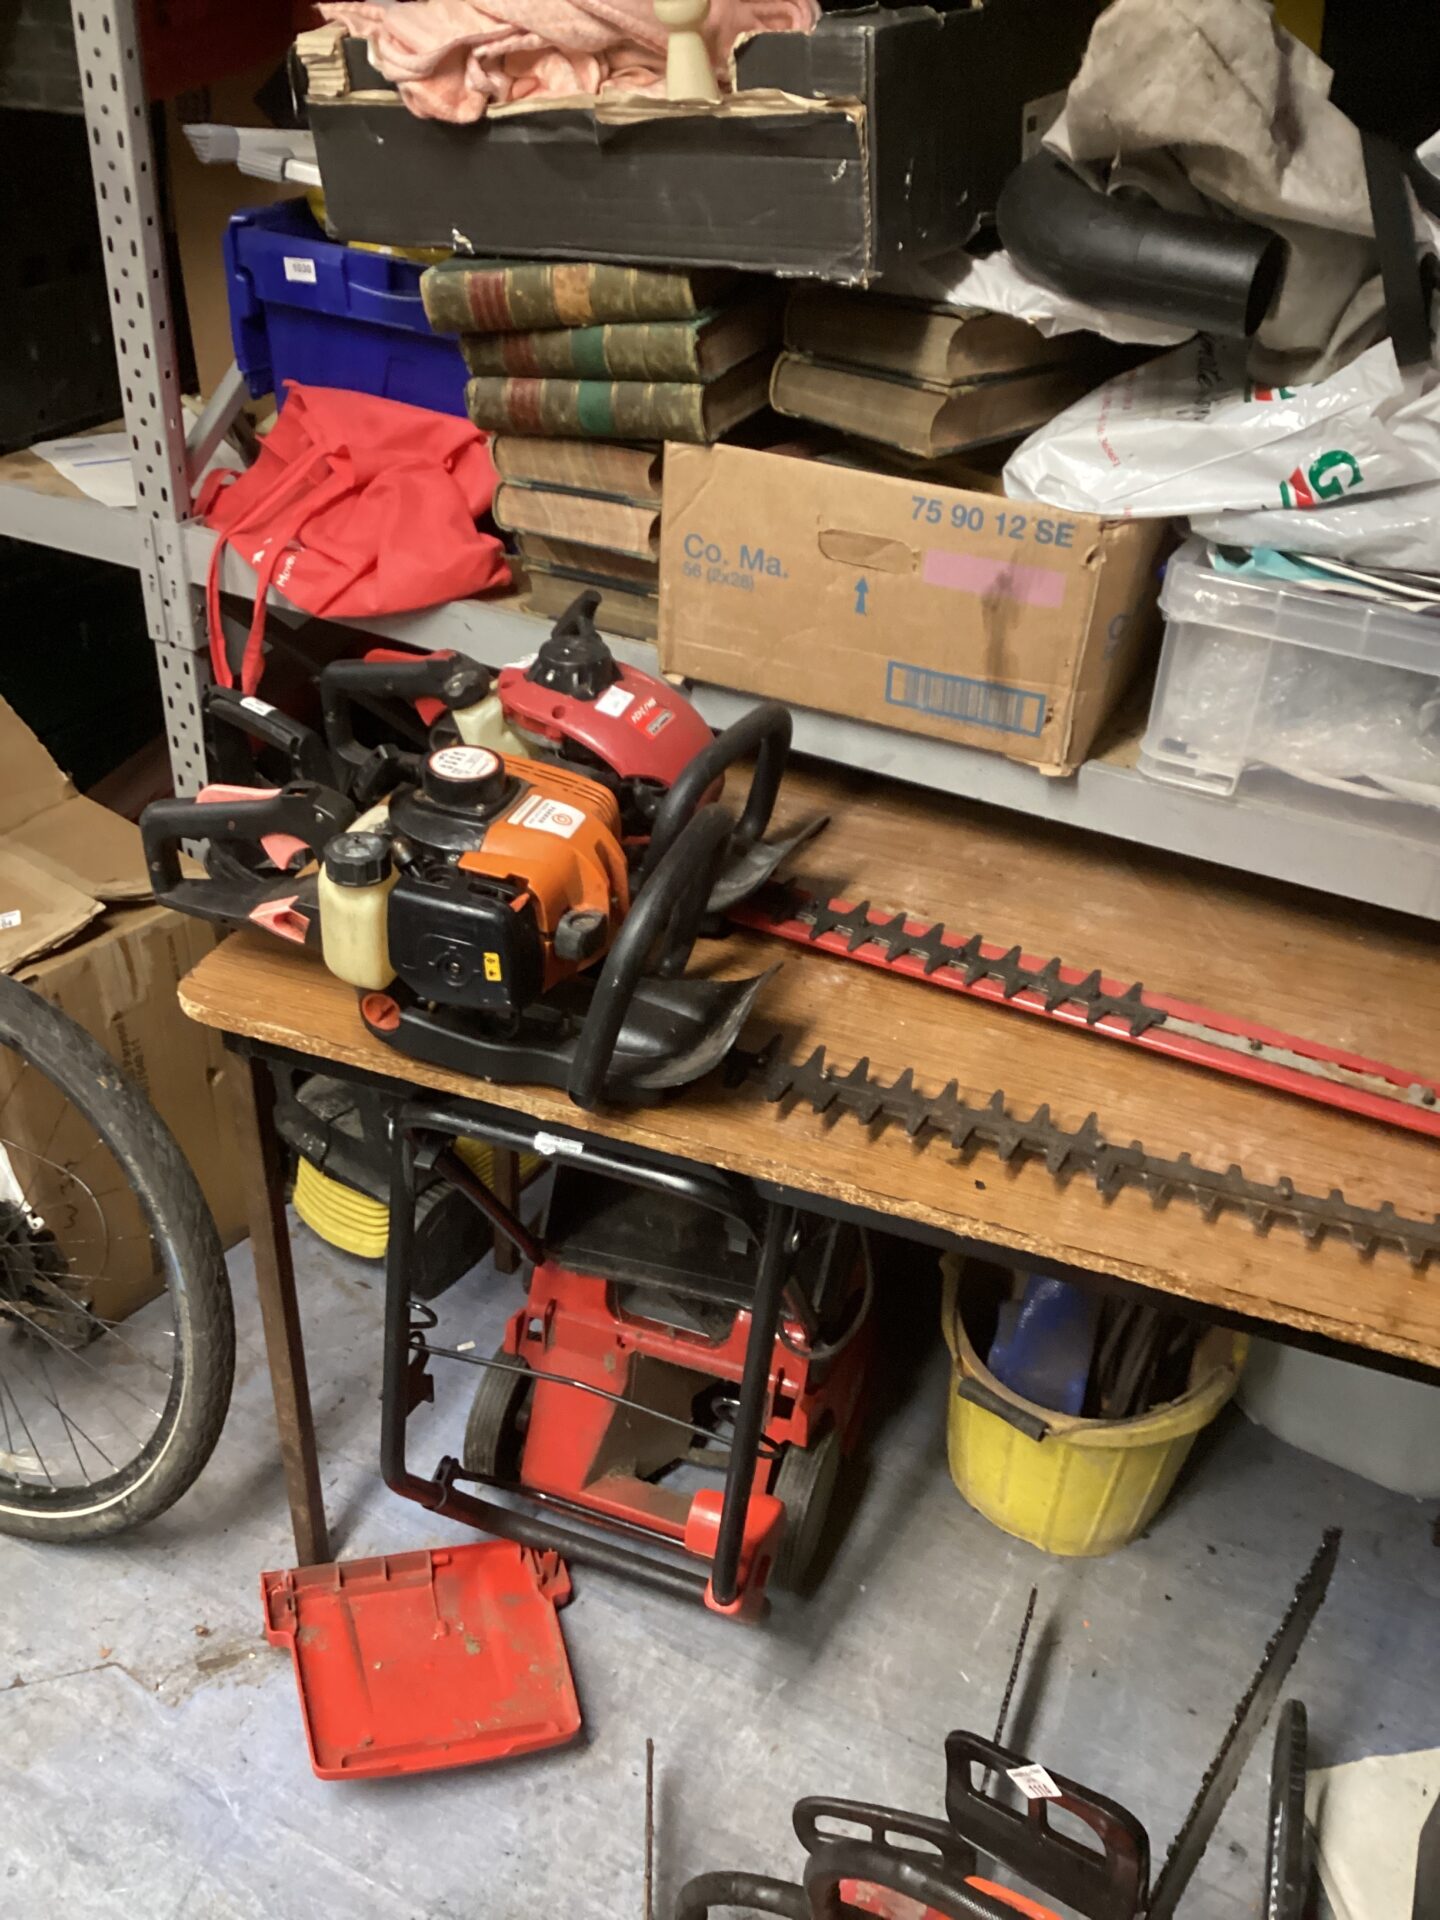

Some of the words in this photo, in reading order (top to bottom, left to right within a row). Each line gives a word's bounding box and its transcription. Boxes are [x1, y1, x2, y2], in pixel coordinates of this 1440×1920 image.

[911, 495, 943, 525] 75
[951, 503, 985, 532] 90
[995, 512, 1027, 541] 12
[1034, 517, 1076, 549] SE
[683, 533, 730, 566] Co.
[740, 544, 789, 579] Ma.
